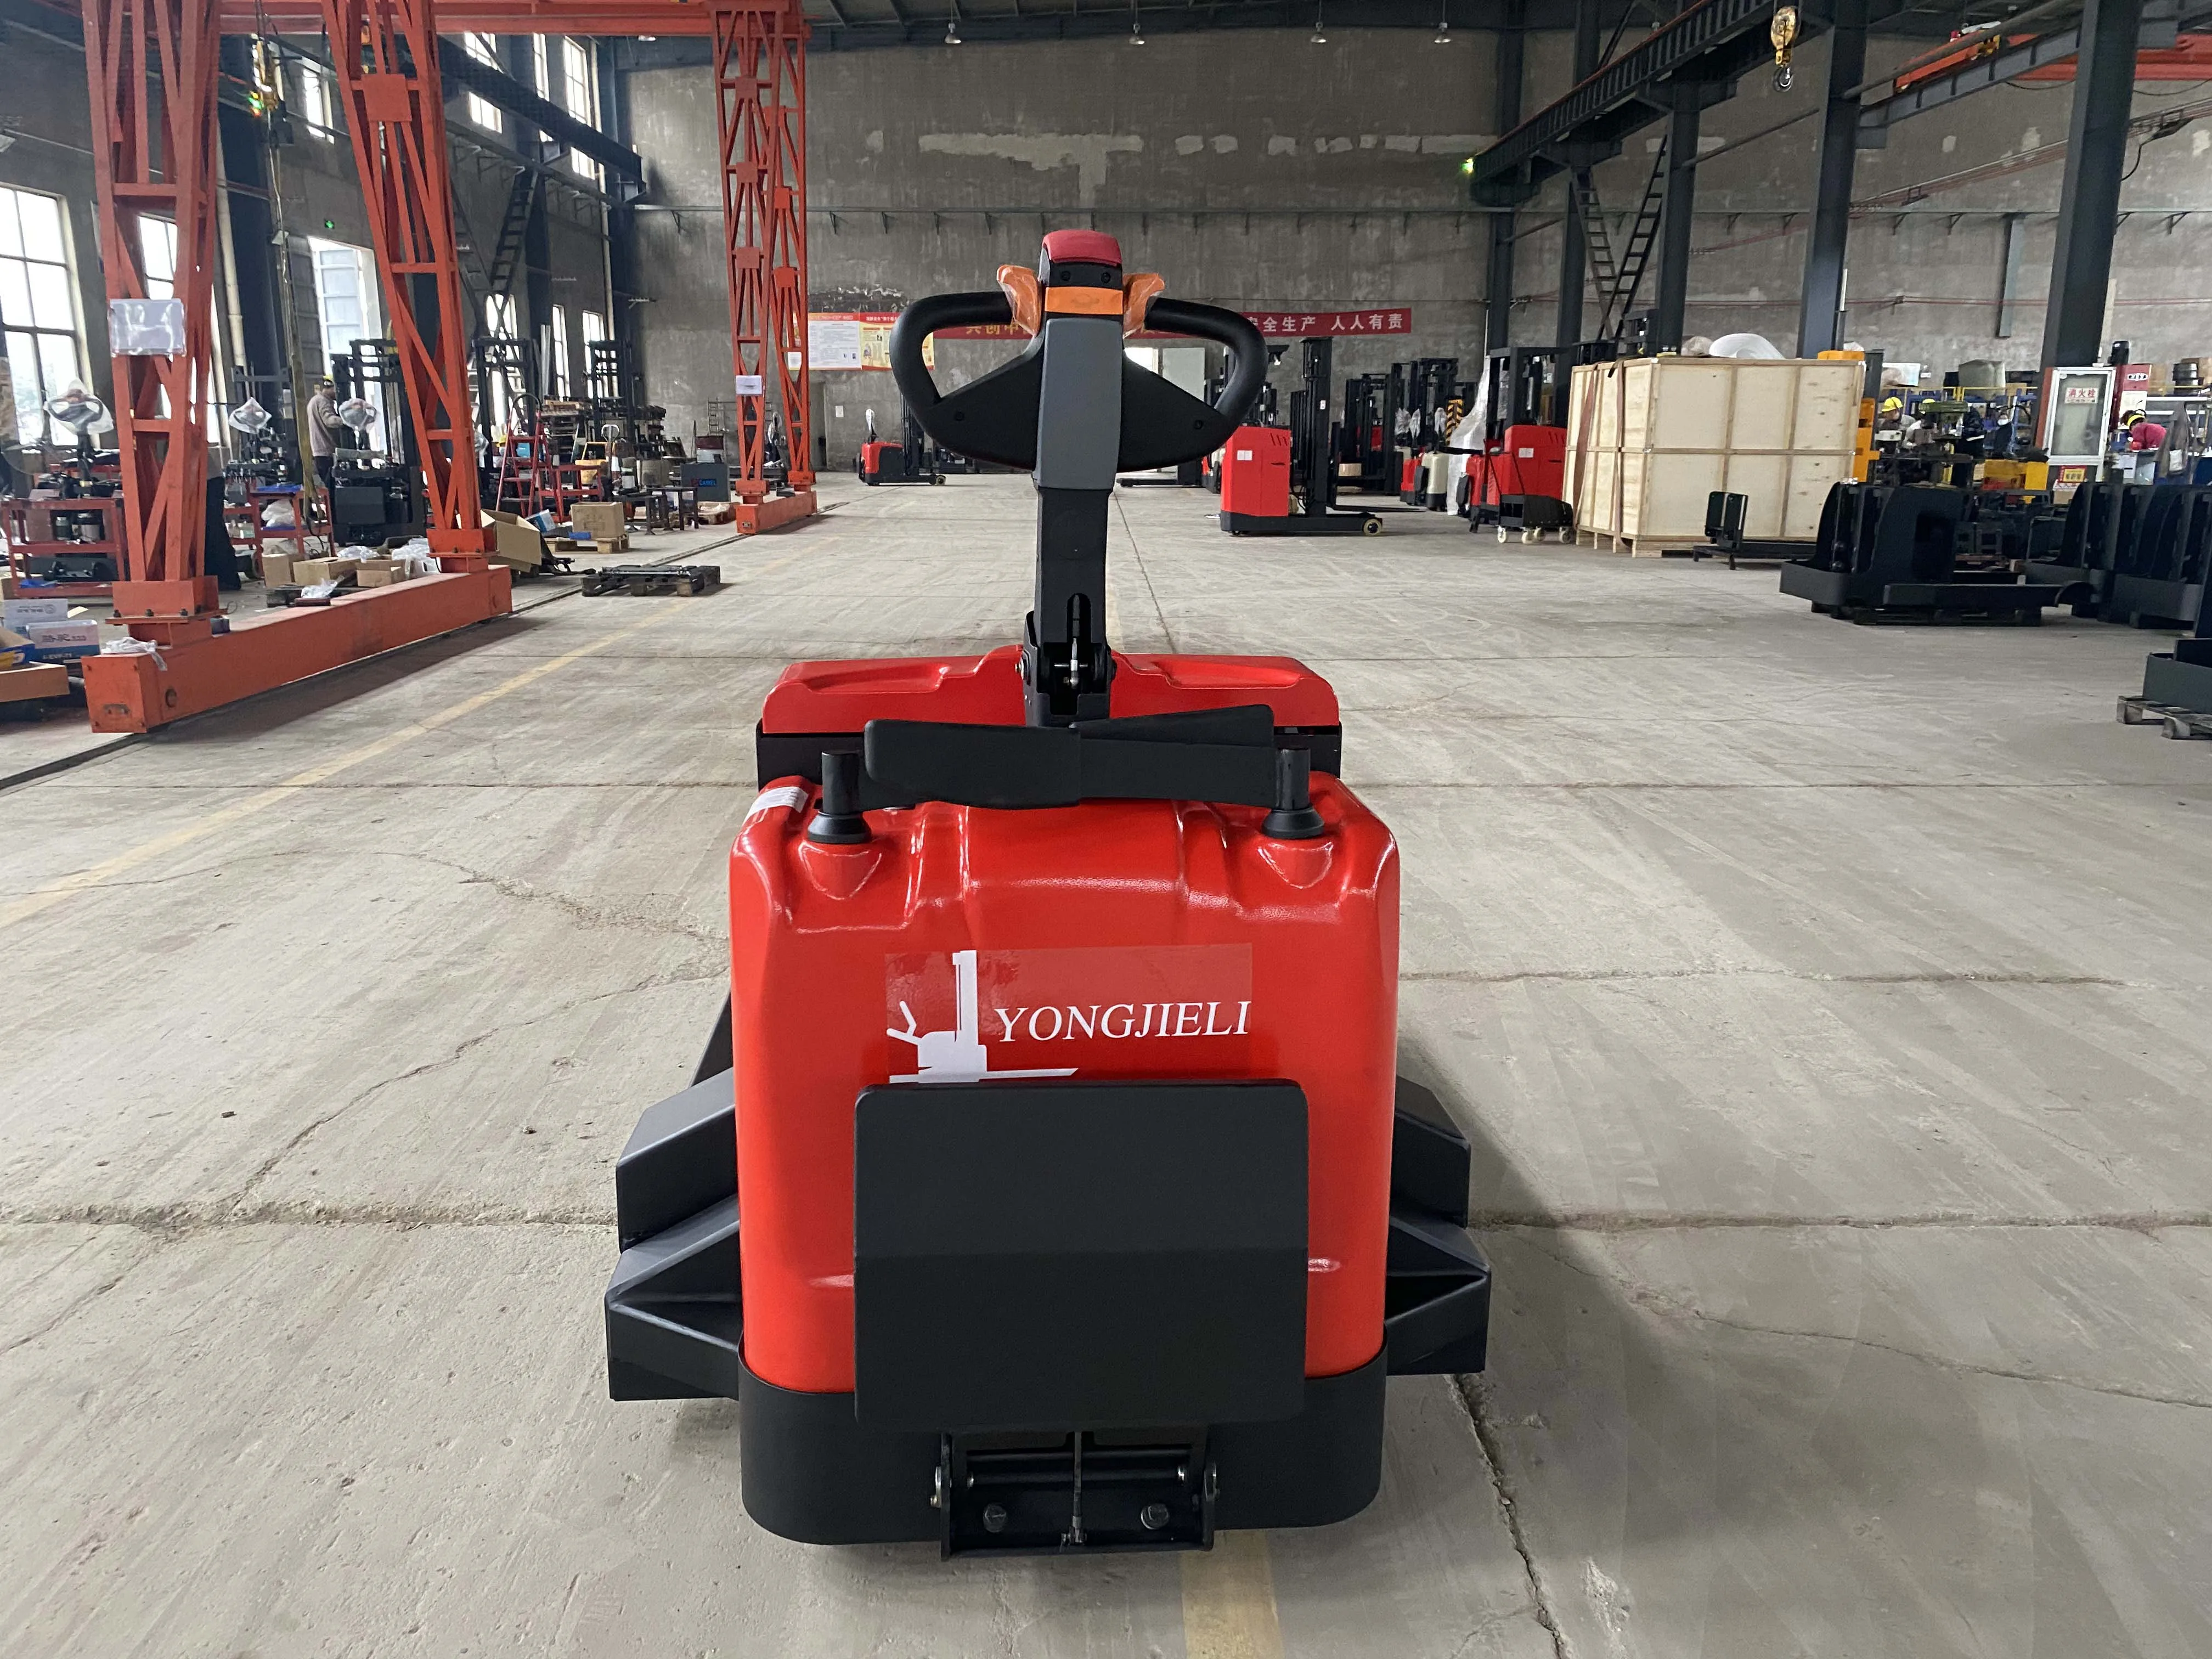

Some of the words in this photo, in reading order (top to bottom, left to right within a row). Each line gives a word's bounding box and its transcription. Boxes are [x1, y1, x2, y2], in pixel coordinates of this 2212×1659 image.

[1331, 313, 1403, 331] 人人有责
[2068, 388, 2096, 398] 消火栓
[994, 1001, 1251, 1042] YONGJIELI
